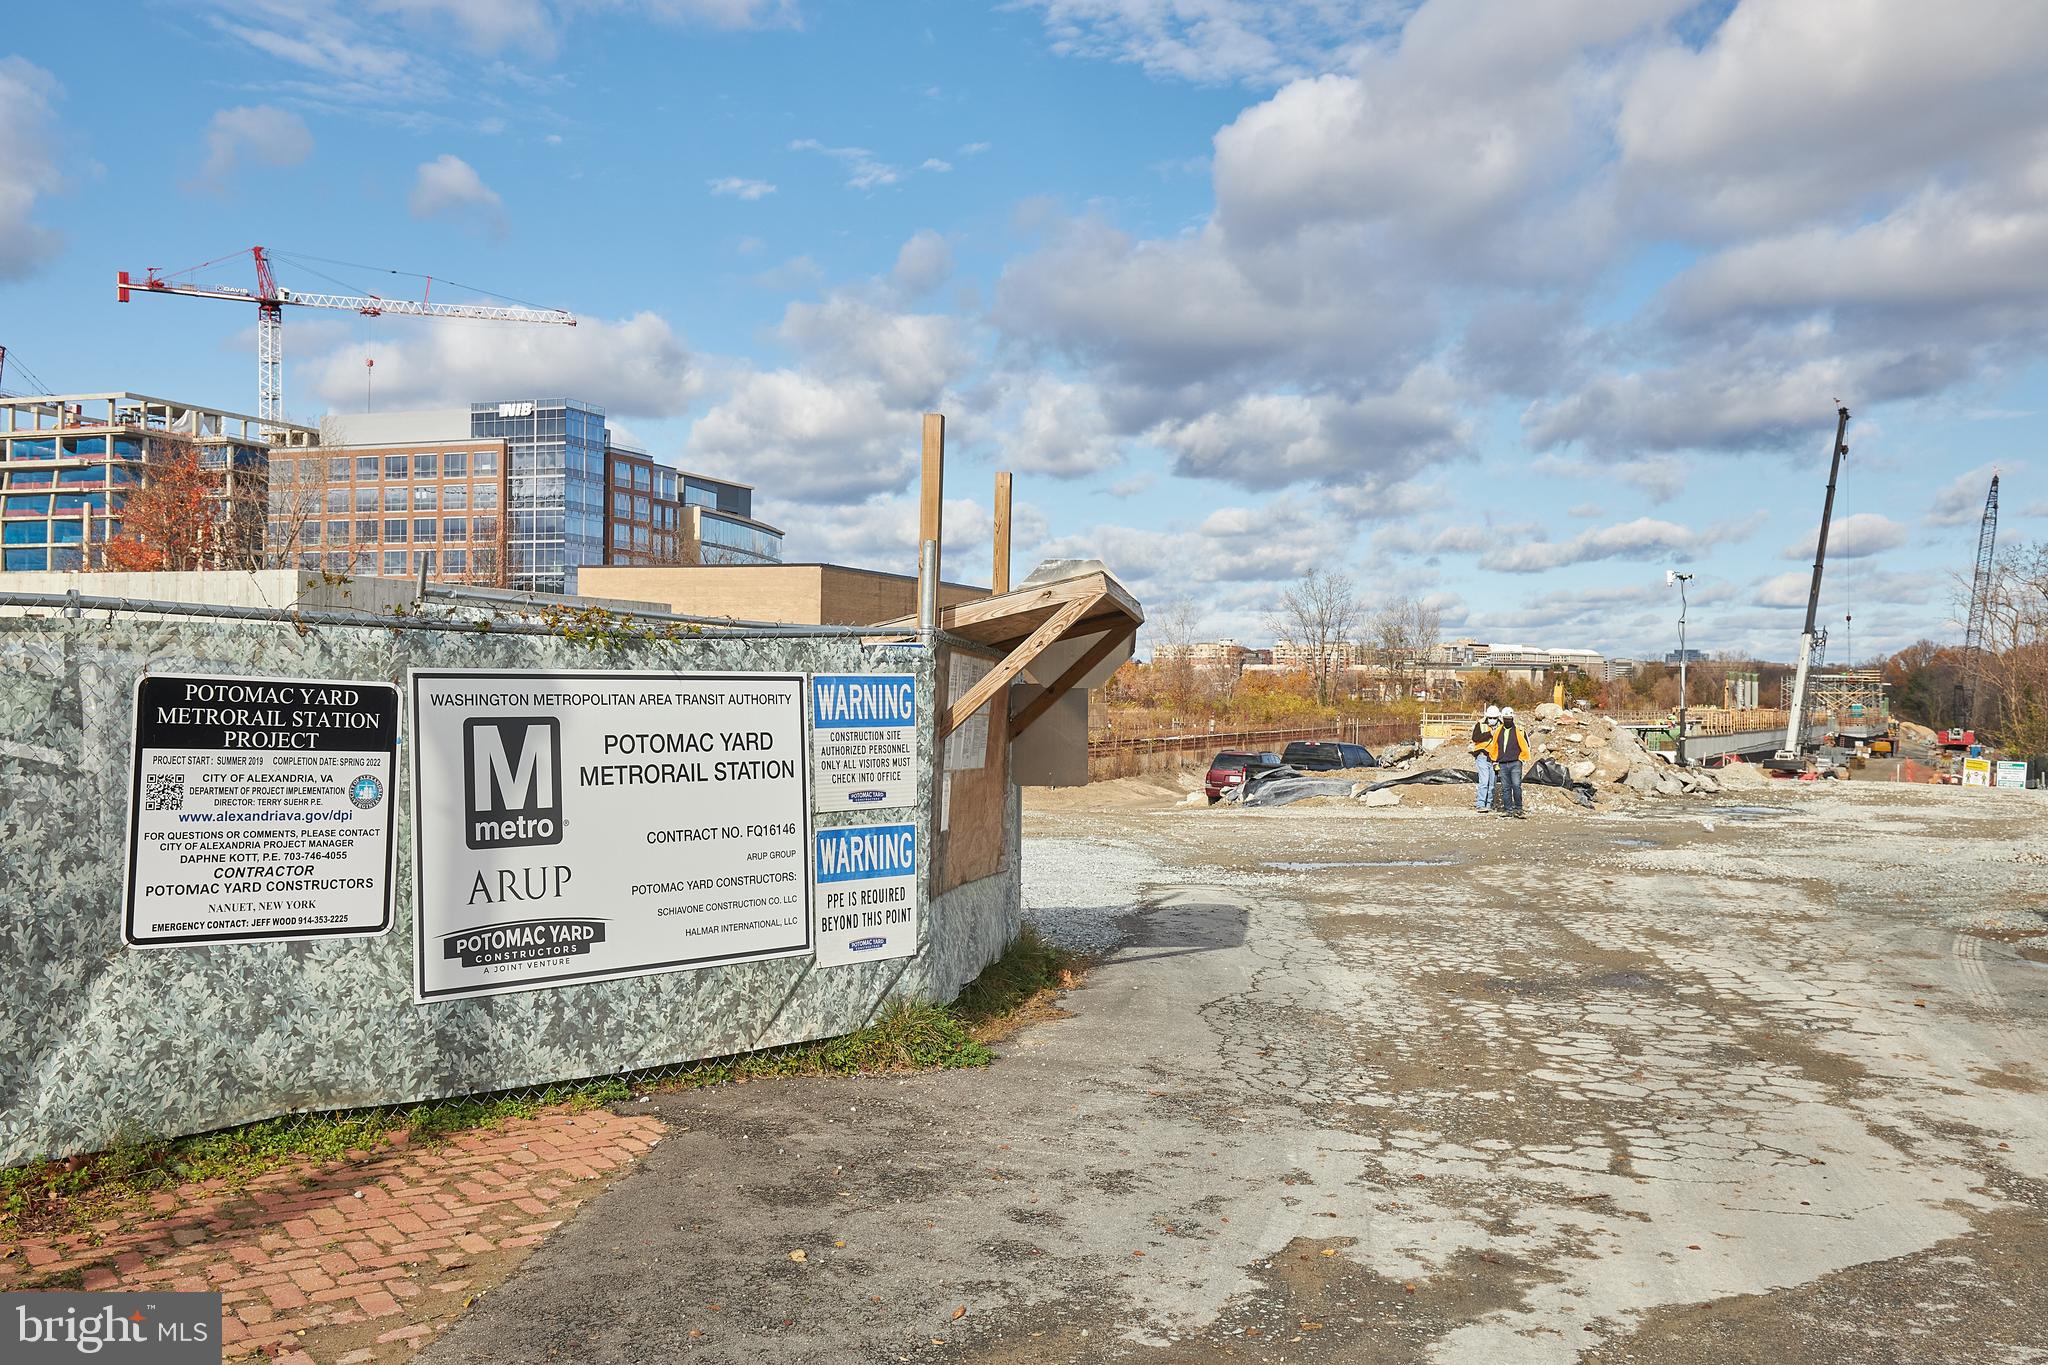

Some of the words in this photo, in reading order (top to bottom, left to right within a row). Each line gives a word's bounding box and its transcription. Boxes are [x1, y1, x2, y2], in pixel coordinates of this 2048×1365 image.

[185, 684, 294, 704] POTOMAC
[299, 688, 359, 706] YARD
[430, 693, 529, 706] WASHINGTON
[533, 693, 635, 706] METROPOLITAN
[639, 694, 672, 705] AREA
[675, 693, 725, 705] TRANSIT
[728, 694, 792, 705] AUTHORITY
[817, 684, 912, 721] WARNING
[157, 707, 286, 727] METRORAIL
[292, 711, 380, 729] STATION
[224, 731, 319, 749] PROJECT
[604, 733, 714, 754] POTOMAC
[720, 732, 773, 751] YARD
[830, 731, 884, 742] CONSTRUCTION
[886, 730, 901, 740] SITE
[821, 745, 866, 756] AUTHORIZED
[869, 743, 910, 754] PERSONNEL
[152, 755, 186, 765] PROJECT
[216, 756, 247, 765] SUMMER
[248, 756, 264, 766] 2019
[272, 756, 318, 766] COMPLETION
[319, 757, 339, 766] DATE:
[339, 757, 365, 767] SPRING
[366, 758, 381, 767] 2022
[473, 724, 553, 812] M
[821, 760, 841, 771] ONLY
[843, 759, 857, 769] ALL
[858, 758, 890, 769] VISITORS
[892, 757, 910, 767] MUST
[202, 773, 227, 783] CITY
[230, 774, 245, 783] OF
[246, 774, 317, 784] ALEXANDRIA,
[320, 774, 334, 783] VA
[580, 763, 708, 786] METRORAIL
[714, 760, 794, 781] STATION
[831, 773, 856, 784] CHECK
[858, 772, 875, 783] INTO
[877, 771, 901, 782] OFFICE
[189, 786, 239, 795] DEPARTMENT
[240, 786, 250, 795] OF
[251, 786, 285, 795] PROJECT
[286, 786, 345, 795] IMPLEMENTATION
[214, 798, 255, 806] DIRECTOR:
[257, 798, 282, 806] TERRY
[283, 798, 309, 806] SUEHR
[310, 798, 323, 806] P.E.
[178, 809, 352, 824] www.alexandriava.gov/dpi
[144, 832, 165, 840] FOR
[167, 831, 224, 840] QUESTIONS
[226, 831, 240, 839] OR
[243, 830, 298, 839] COMMENTS,
[301, 829, 336, 837] PLEASE
[338, 828, 380, 837] CONTACT
[475, 816, 554, 841] metro
[647, 827, 718, 844] CONTRACT
[722, 826, 743, 839] NO.
[747, 823, 796, 837] FQ16146
[160, 843, 182, 851] CITY
[182, 842, 198, 851] OF
[199, 841, 261, 850] ALEXANDRIA
[263, 840, 306, 849] PROJECT
[308, 839, 354, 848] MANAGER
[819, 832, 913, 875] WARNING
[180, 854, 226, 864] DAPHNE
[229, 853, 259, 863] KOTT,
[262, 852, 281, 861] P.E.
[284, 851, 347, 861] 703-746-4055
[746, 852, 768, 861] ARUP
[769, 849, 796, 860] GROUP
[214, 865, 314, 879] CONTRACTOR
[146, 883, 220, 897] POTOMAC
[224, 882, 262, 893] YARD
[266, 878, 373, 892] CONSTRUCTORS
[466, 865, 571, 905] ARUP
[632, 881, 684, 895] POTOMAC
[686, 879, 714, 890] YARD
[716, 871, 797, 888] CONSTRUCTORS:
[208, 902, 256, 913] NANUET,
[258, 901, 283, 911] NEW
[286, 900, 316, 909] YORK
[657, 904, 704, 917] SCHIAVONE
[705, 898, 767, 912] CONSTRUCTION
[768, 896, 782, 905] CO.
[783, 895, 798, 905] LLC
[827, 892, 844, 909] PPE
[848, 891, 857, 907] IS
[861, 886, 905, 905] REQUIRED
[152, 921, 205, 932] EMERGENCY
[207, 919, 249, 929] CONTACT:
[251, 918, 271, 927] JEFF
[272, 917, 297, 926] WOOD
[298, 914, 348, 925] 914-353-2225
[685, 925, 719, 937] HALMAR
[720, 918, 782, 935] INTERNATIONAL,
[783, 916, 798, 927] LLC
[821, 913, 859, 932] BEYOND
[862, 910, 882, 927] THIS
[886, 907, 912, 924] POINT
[457, 925, 546, 953] POTOMAC
[549, 925, 594, 943] YARD
[475, 944, 577, 963] CONSTRUCTORS
[494, 963, 522, 973] JOINT
[527, 957, 570, 969] VENTURE
